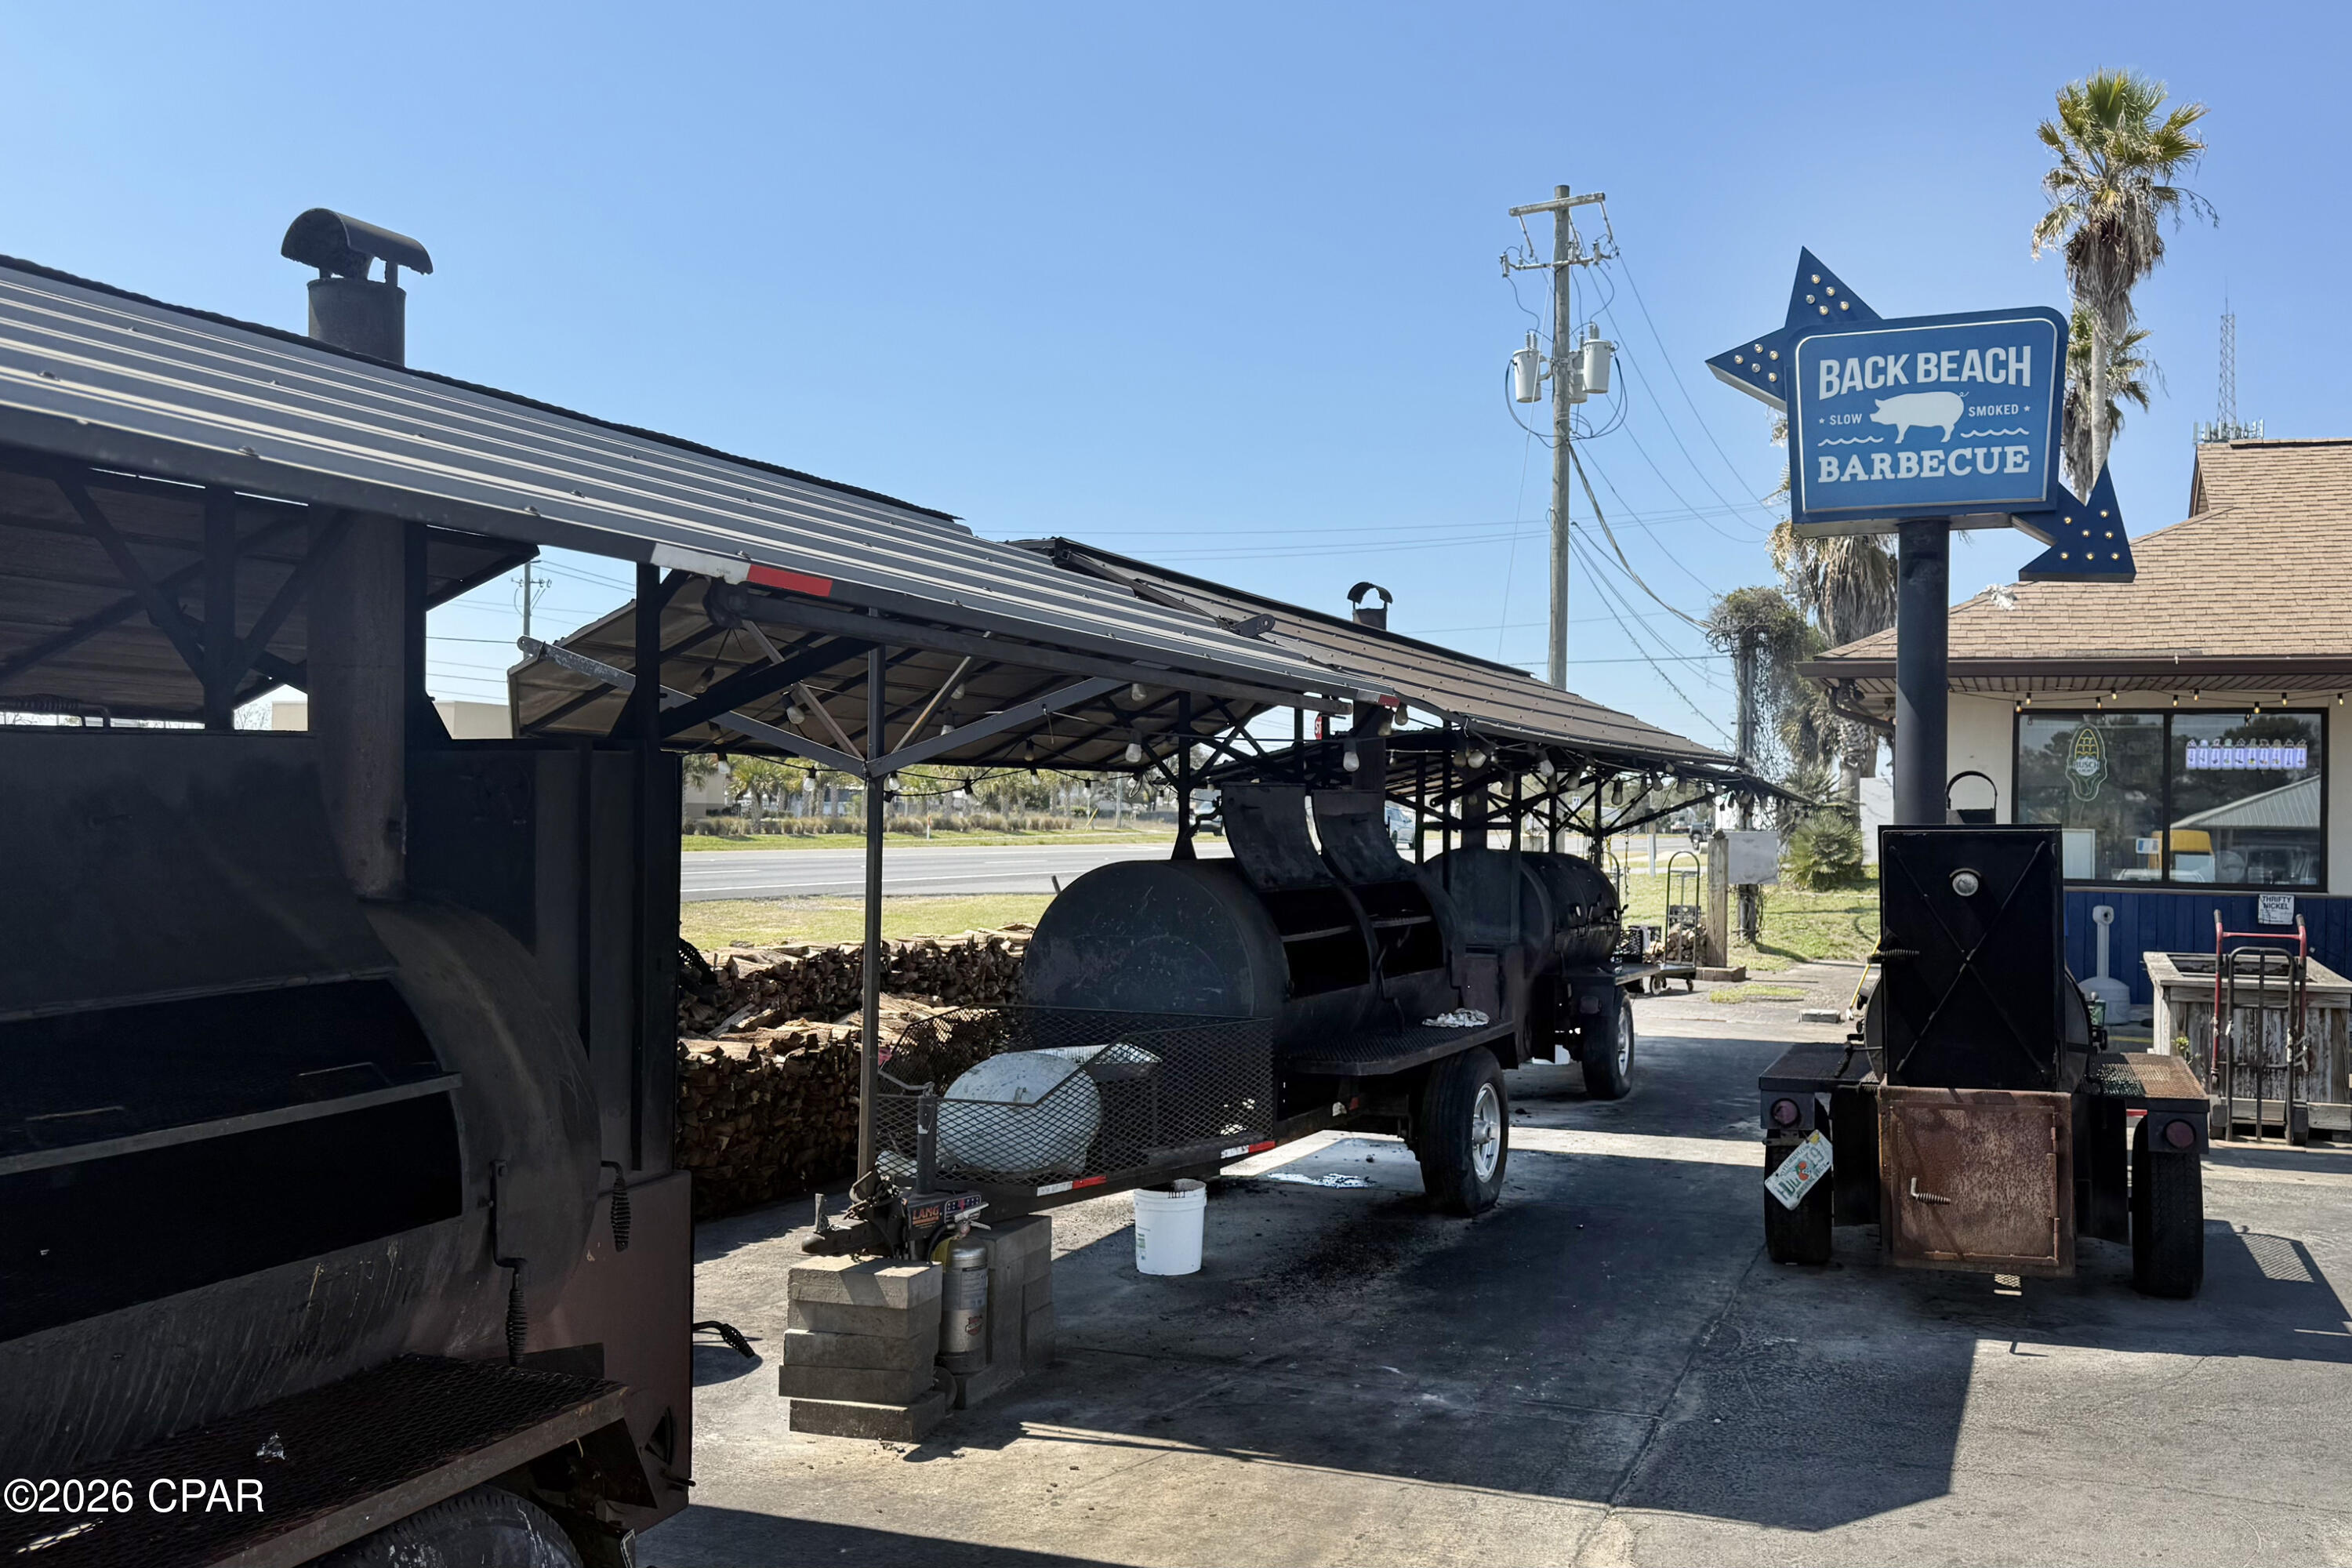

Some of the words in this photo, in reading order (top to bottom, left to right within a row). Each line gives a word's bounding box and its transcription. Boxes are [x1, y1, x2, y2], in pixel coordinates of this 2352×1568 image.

[1819, 354, 1909, 400] BACK
[1917, 346, 2031, 387] BEACH
[1829, 413, 1862, 426] SLOW
[1968, 404, 2019, 417] SMOKED
[1818, 445, 2031, 483] BARBECUE
[913, 1205, 940, 1221] LANG
